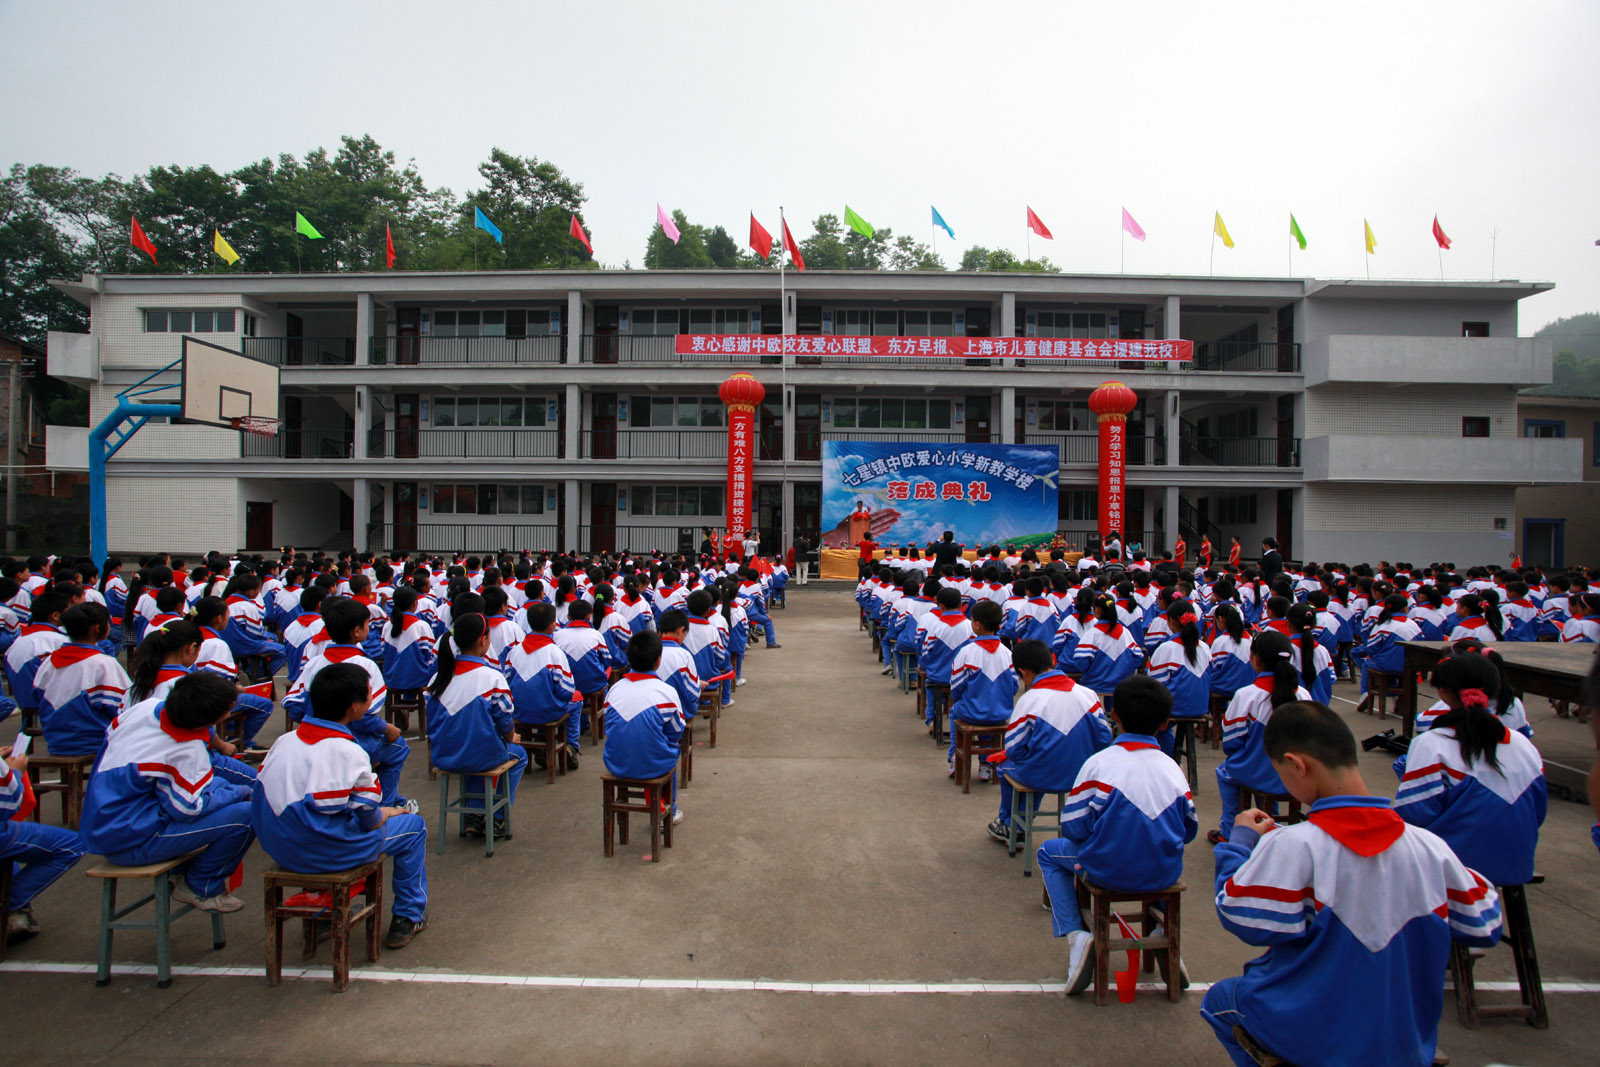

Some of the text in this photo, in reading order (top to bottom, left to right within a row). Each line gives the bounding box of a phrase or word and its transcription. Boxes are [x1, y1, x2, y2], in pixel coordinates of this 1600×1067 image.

[842, 449, 1037, 491] 七星镇中欧爱心小学新教学楼
[886, 480, 992, 502] 落成典礼
